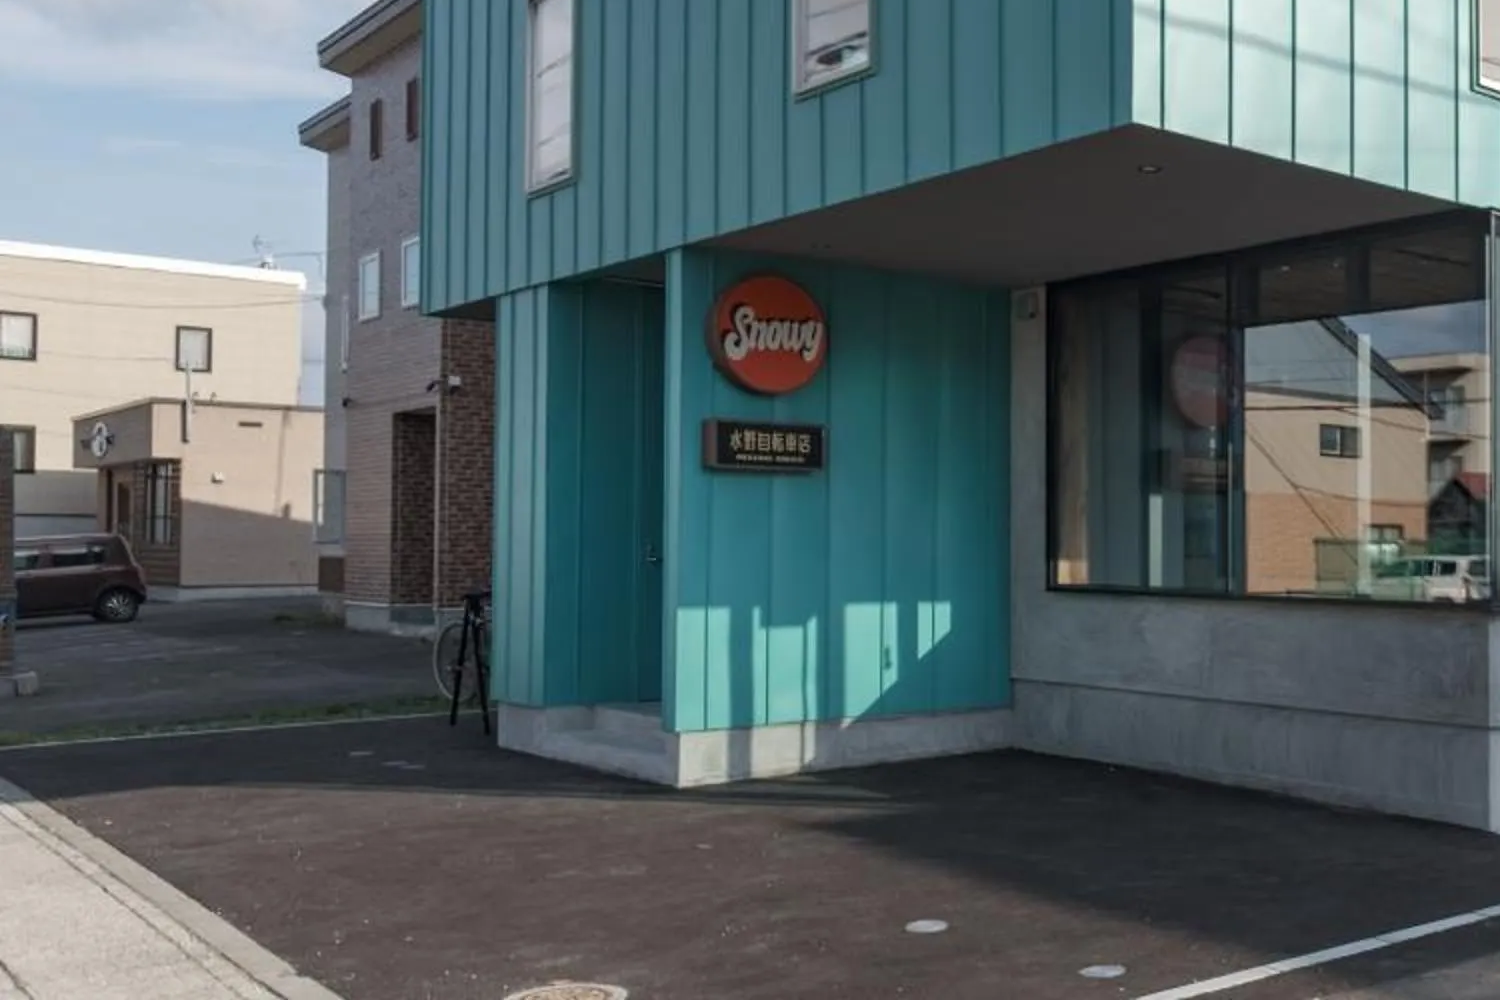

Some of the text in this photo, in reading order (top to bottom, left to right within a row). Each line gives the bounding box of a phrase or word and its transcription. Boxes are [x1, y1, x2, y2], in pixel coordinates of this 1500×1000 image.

[724, 305, 823, 361] Snowy
[730, 429, 812, 453] 水野自転車店
